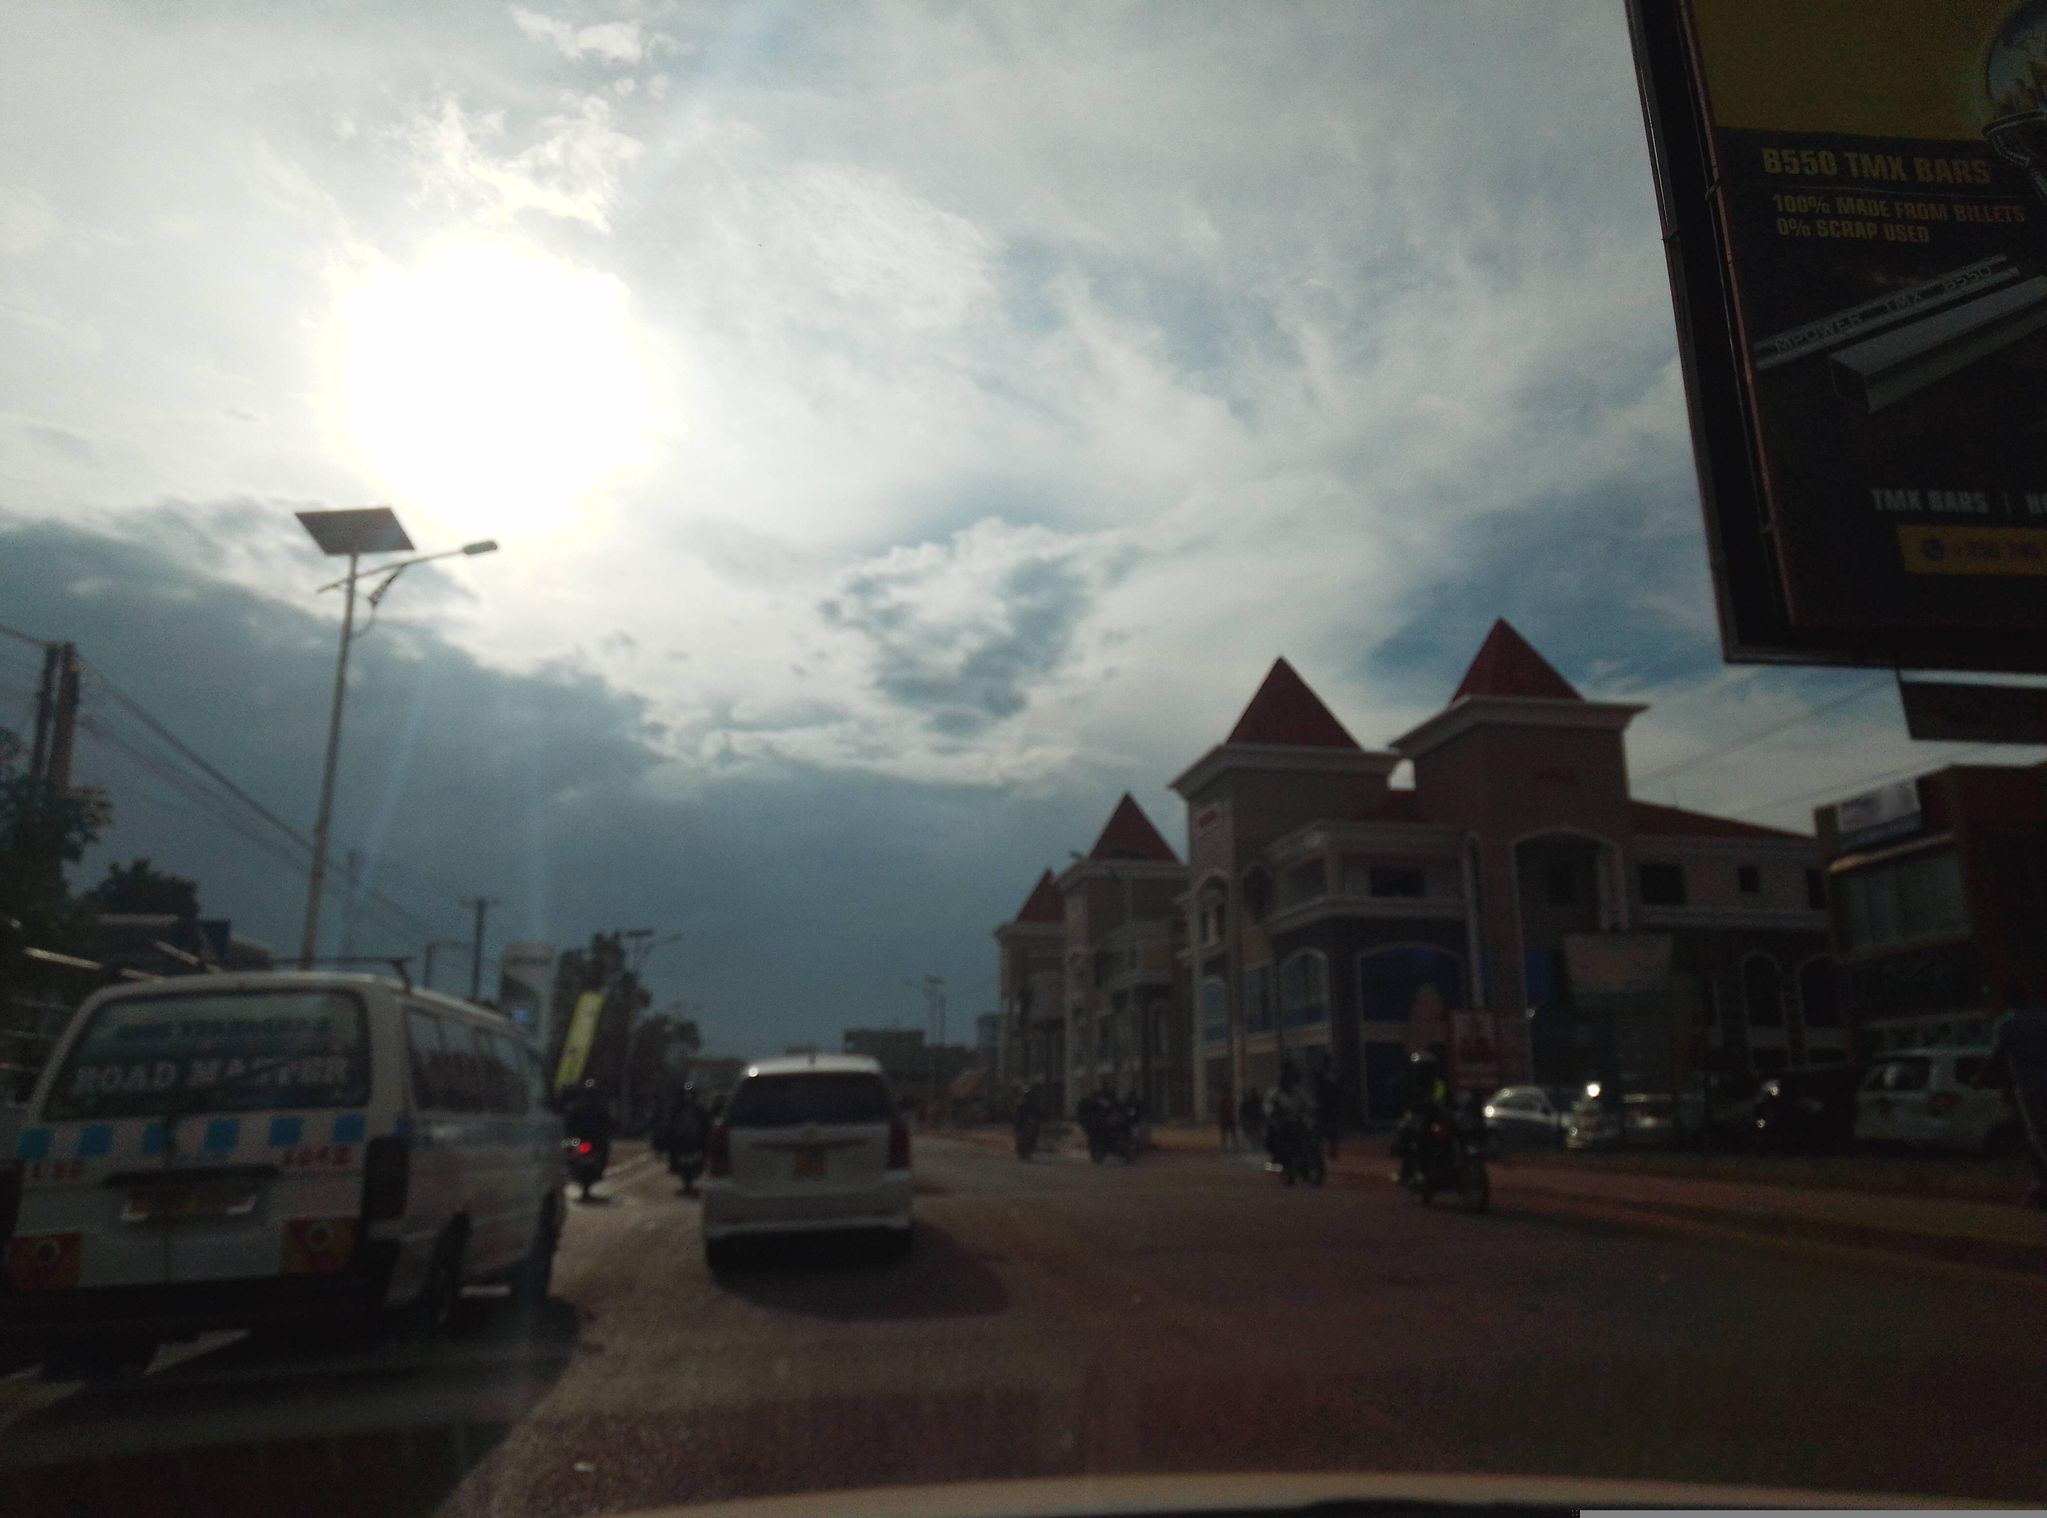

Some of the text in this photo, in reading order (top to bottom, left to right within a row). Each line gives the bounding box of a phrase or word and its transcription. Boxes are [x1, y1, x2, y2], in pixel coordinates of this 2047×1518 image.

[1761, 148, 1992, 185] B550 TMX BARS
[1772, 194, 2027, 224] 100% MADE FROM BILLETS
[1776, 217, 1931, 244] 0% SCRAP USED
[1869, 488, 1990, 514] TMX BARS
[69, 1060, 177, 1097] ROAD
